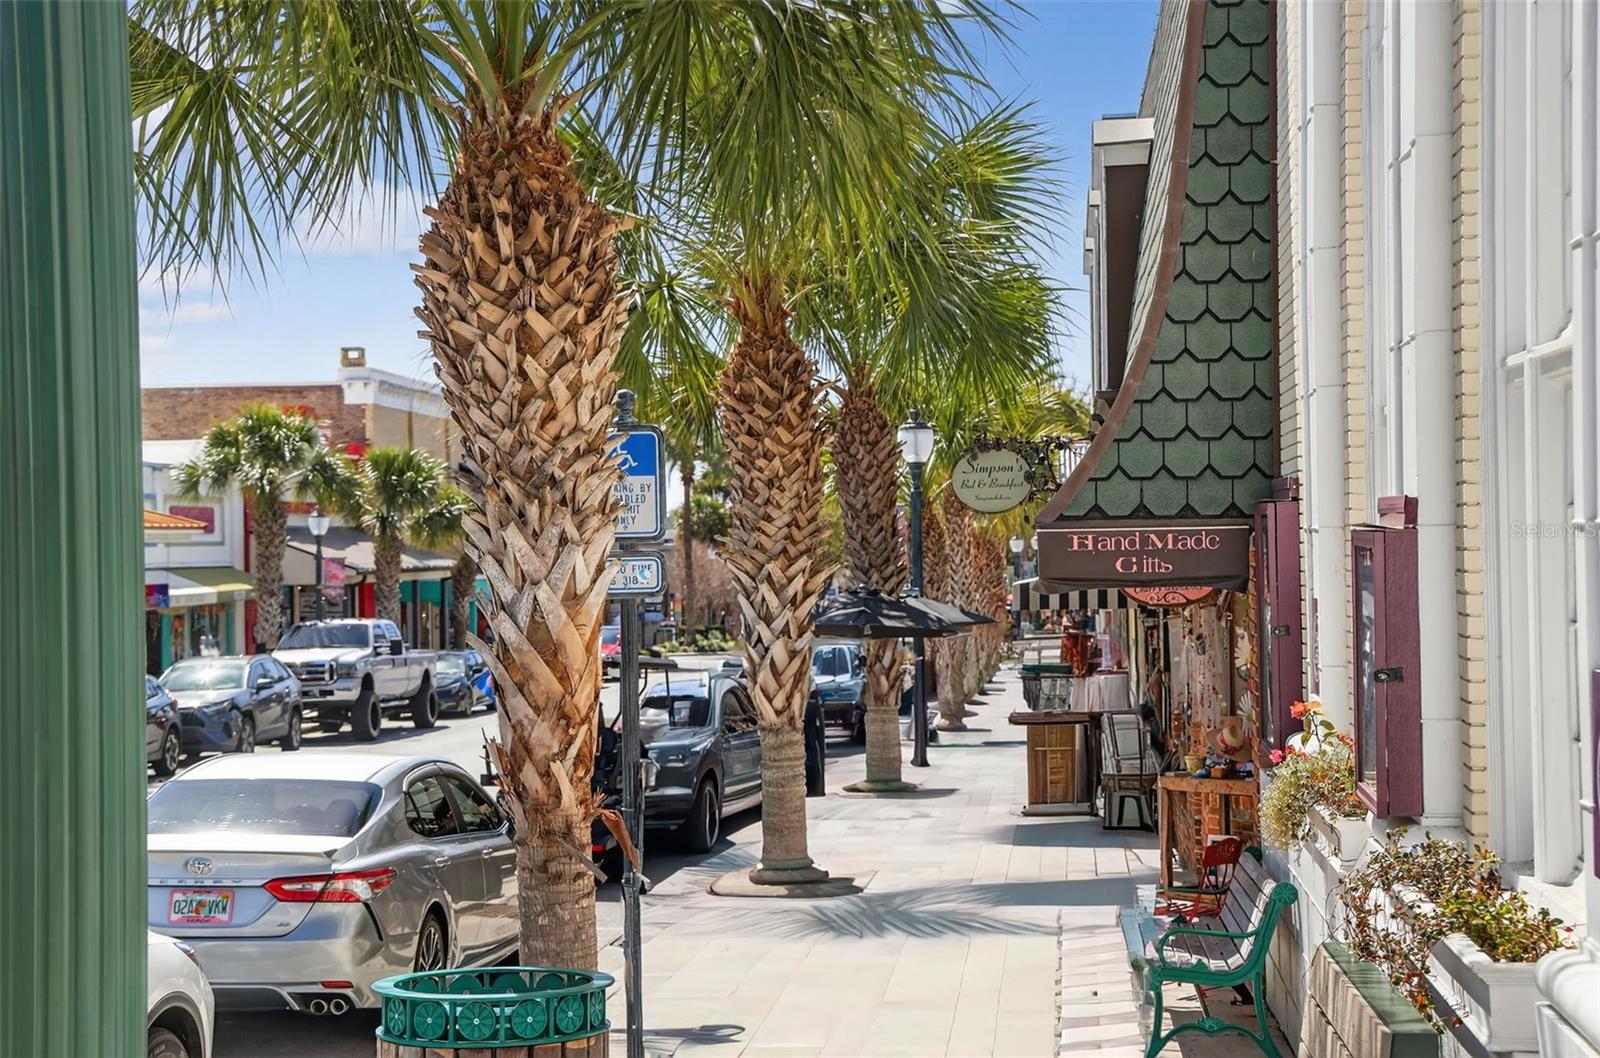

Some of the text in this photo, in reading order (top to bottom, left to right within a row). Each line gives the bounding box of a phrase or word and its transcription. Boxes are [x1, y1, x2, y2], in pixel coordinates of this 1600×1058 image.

[962, 455, 1023, 478] Simpson's
[640, 483, 651, 493] BY
[618, 494, 646, 504] ABLED
[616, 515, 637, 526] NLY
[1068, 531, 1220, 552] Hand Made
[1115, 555, 1173, 573] Gifts
